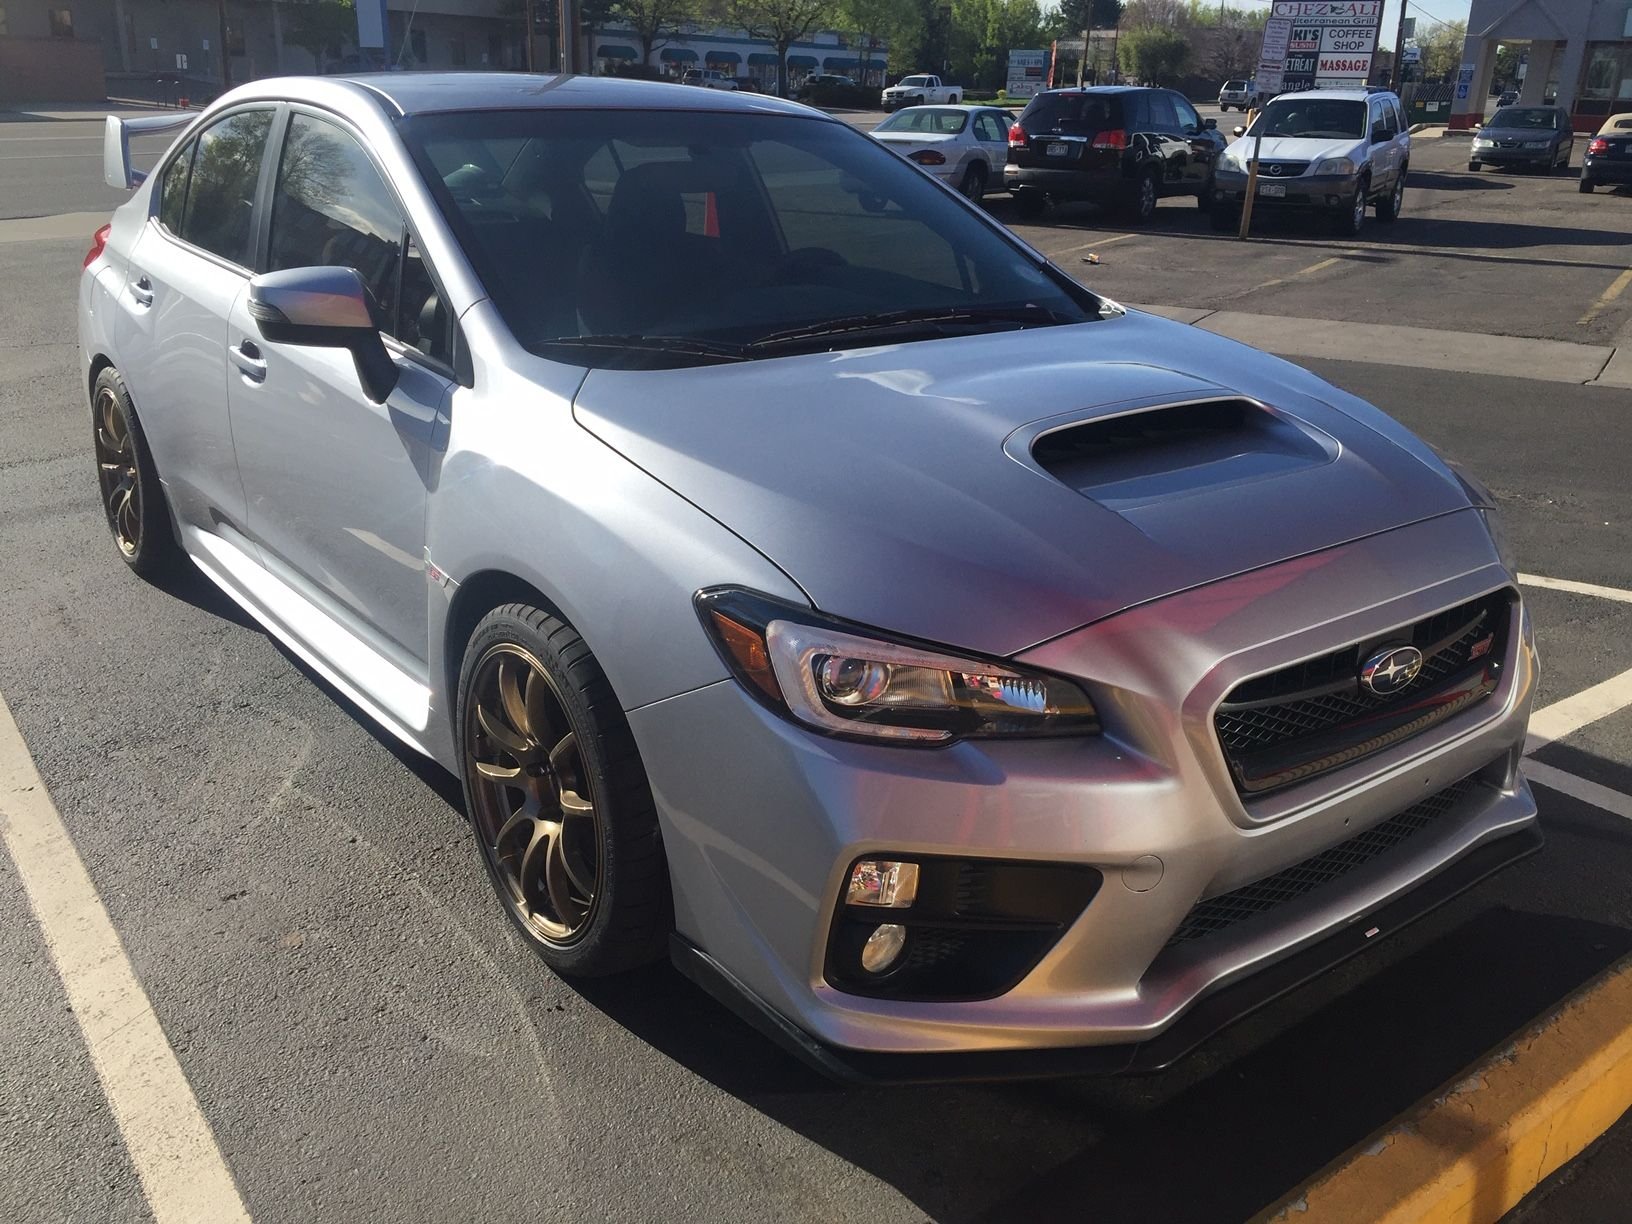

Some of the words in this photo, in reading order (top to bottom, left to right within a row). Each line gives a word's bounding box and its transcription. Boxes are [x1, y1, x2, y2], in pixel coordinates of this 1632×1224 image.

[1275, 3, 1328, 16] CHEZ
[1353, 17, 1375, 25] Grill
[1291, 29, 1319, 41] KI'S
[1329, 29, 1373, 39] COFFEE
[1333, 41, 1364, 50] SHOP
[1285, 58, 1315, 71] ETREAT
[1319, 59, 1368, 72] MASSAGE
[1281, 79, 1311, 92] angle
